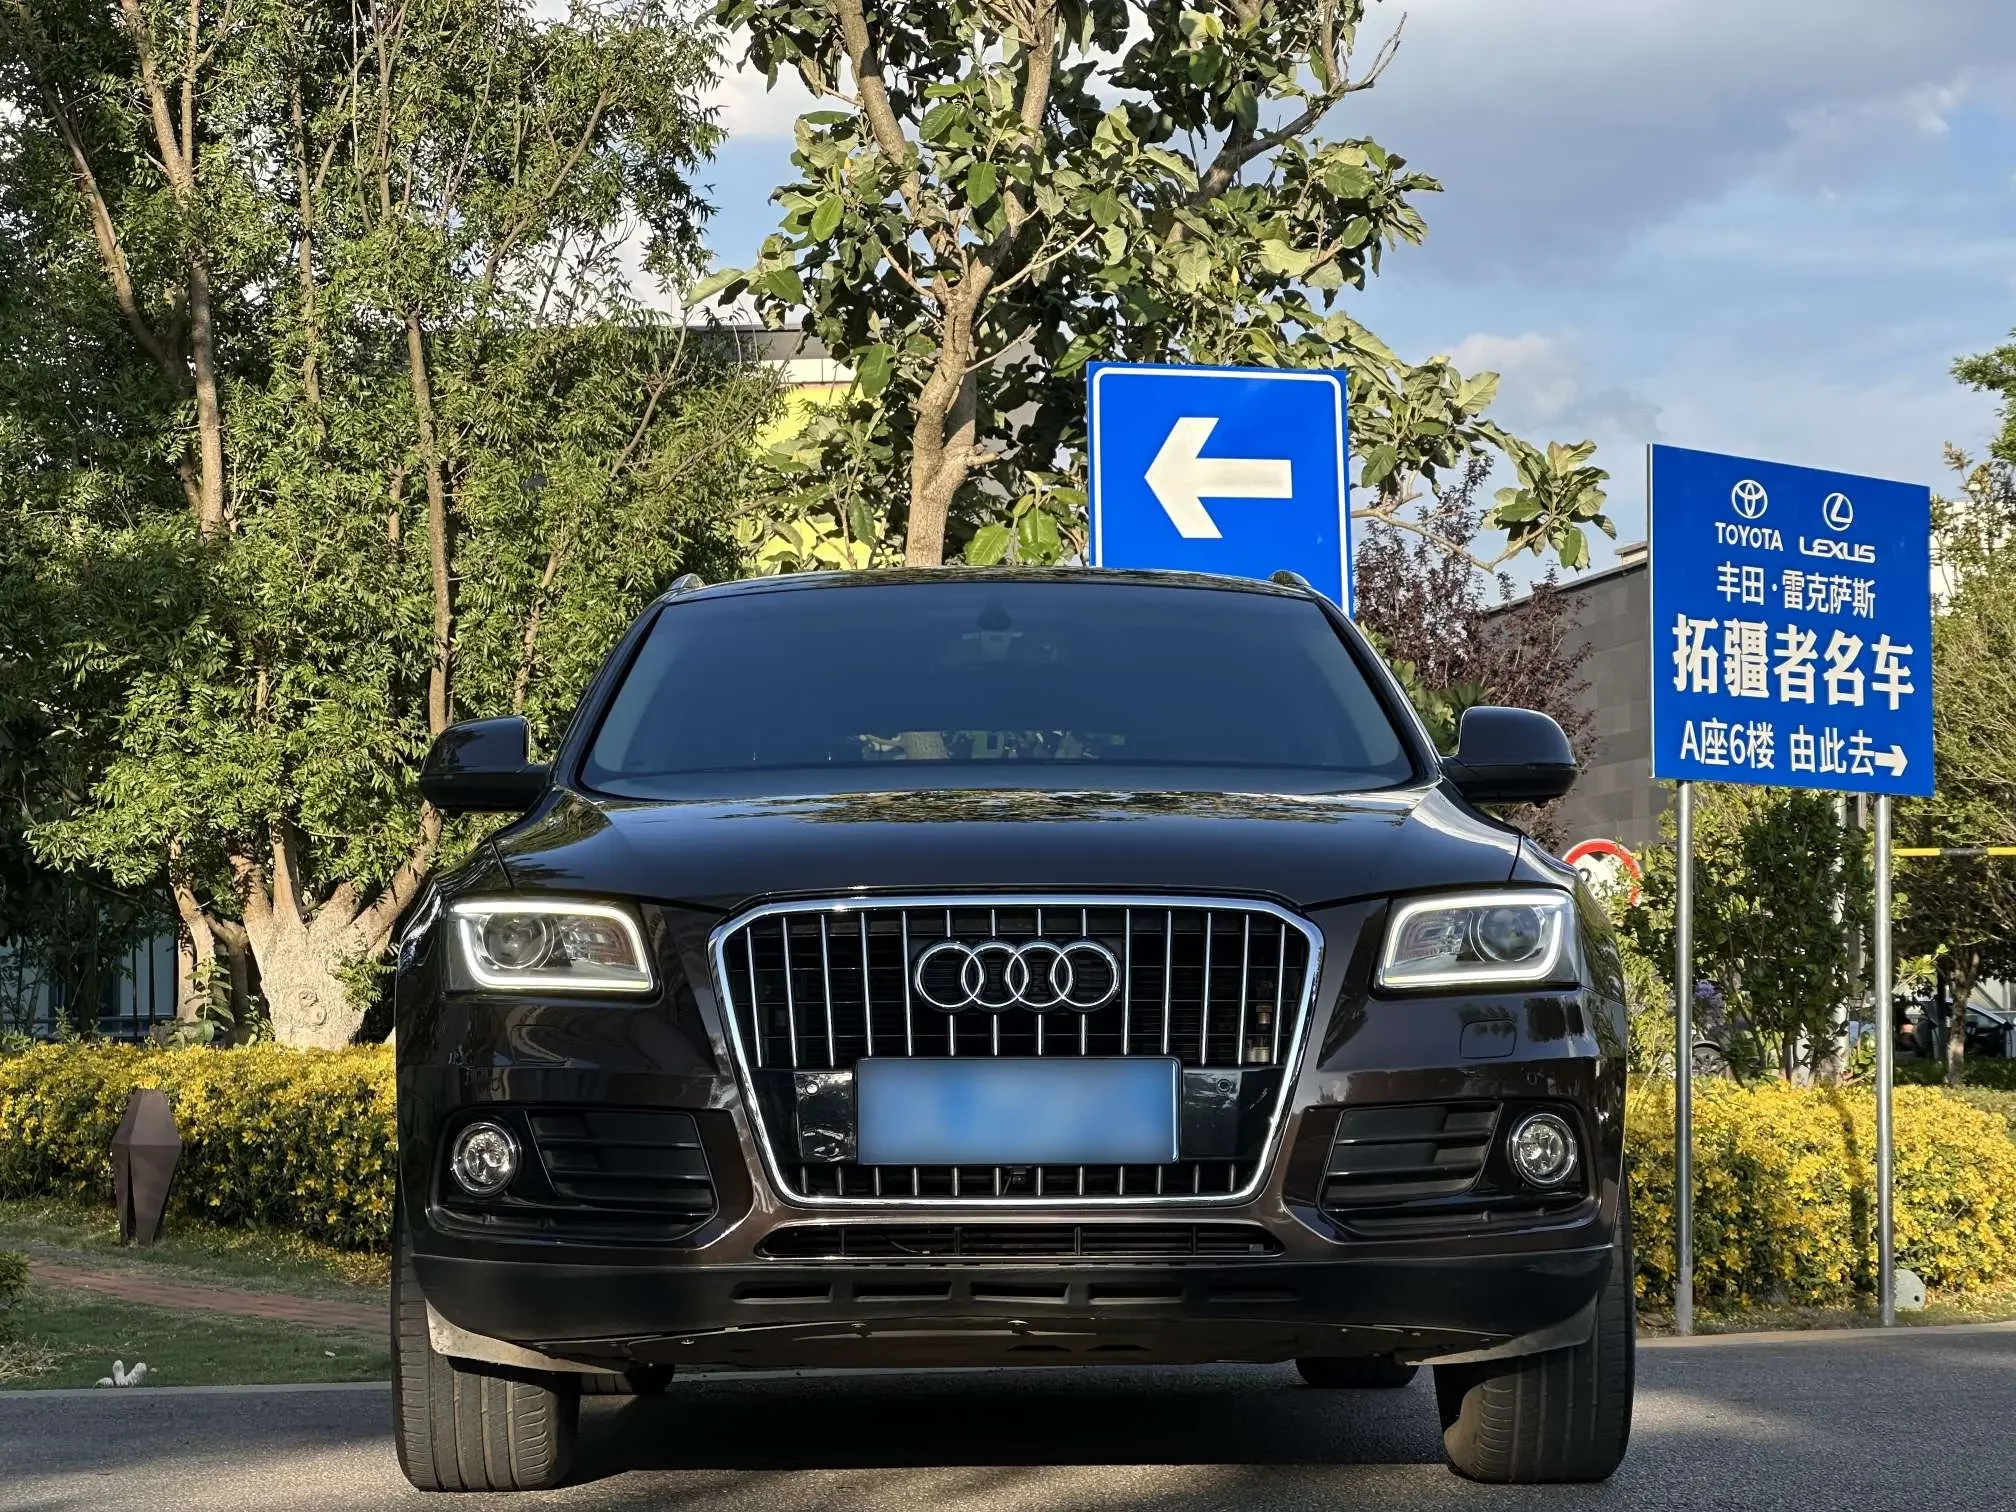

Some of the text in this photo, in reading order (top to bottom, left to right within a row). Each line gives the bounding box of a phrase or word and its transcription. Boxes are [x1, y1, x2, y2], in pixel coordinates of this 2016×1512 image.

[1714, 521, 1784, 552] TOYOTA
[1799, 535, 1876, 564] LEXUS
[1671, 612, 1915, 711] 拓疆者名车
[1680, 717, 1875, 777] A座6楼 由此去
